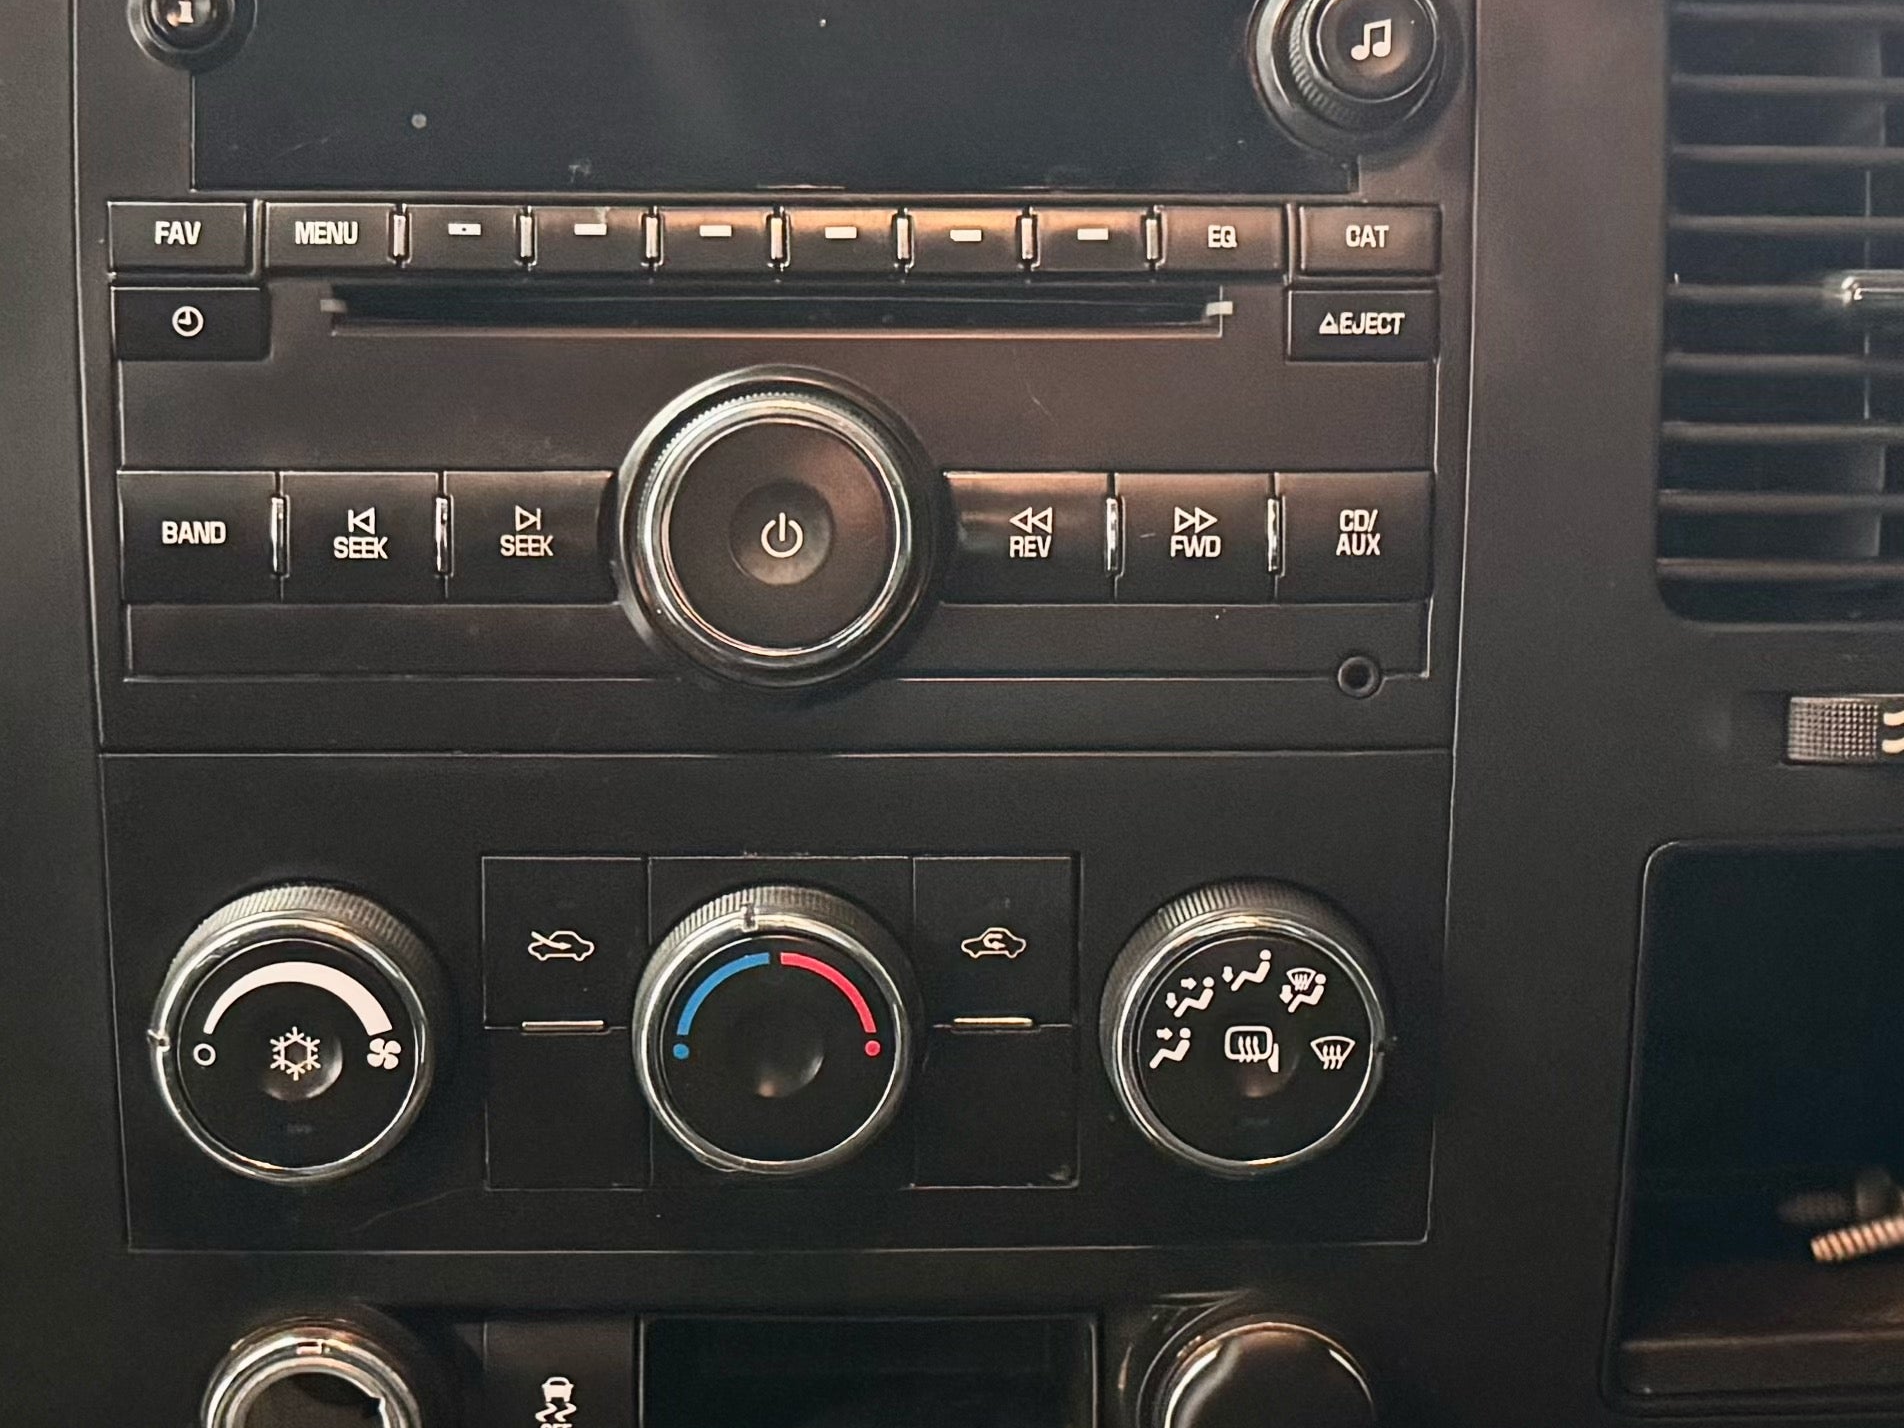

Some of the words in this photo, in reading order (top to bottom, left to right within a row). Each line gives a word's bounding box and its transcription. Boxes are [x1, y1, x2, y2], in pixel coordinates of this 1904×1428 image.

[154, 220, 202, 245] FAV
[294, 221, 358, 245] MENU
[1207, 225, 1238, 249] EQ
[1345, 224, 1390, 248] CAT
[1339, 311, 1405, 335] EJECT
[161, 520, 227, 545] BAND
[1339, 509, 1379, 533] CD/
[333, 536, 388, 560] SEEK
[500, 534, 554, 558] SEEK
[1009, 534, 1053, 558] REV
[1170, 534, 1222, 558] FWD
[1335, 533, 1381, 557] AUX
